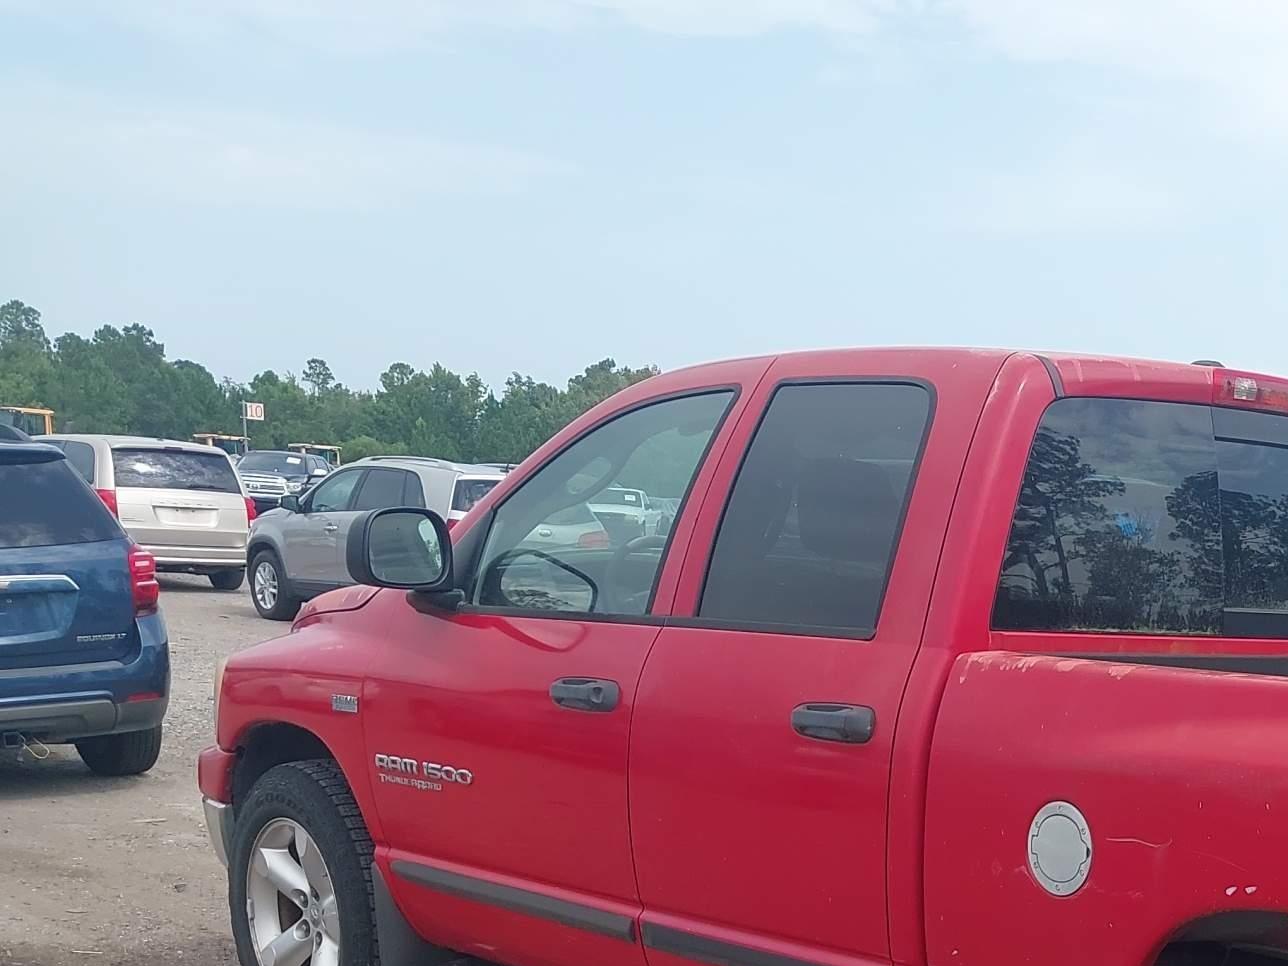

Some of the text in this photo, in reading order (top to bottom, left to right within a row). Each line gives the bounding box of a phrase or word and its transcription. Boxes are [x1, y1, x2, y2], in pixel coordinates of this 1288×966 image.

[249, 404, 263, 418] 10
[375, 754, 473, 785] RAM 1500
